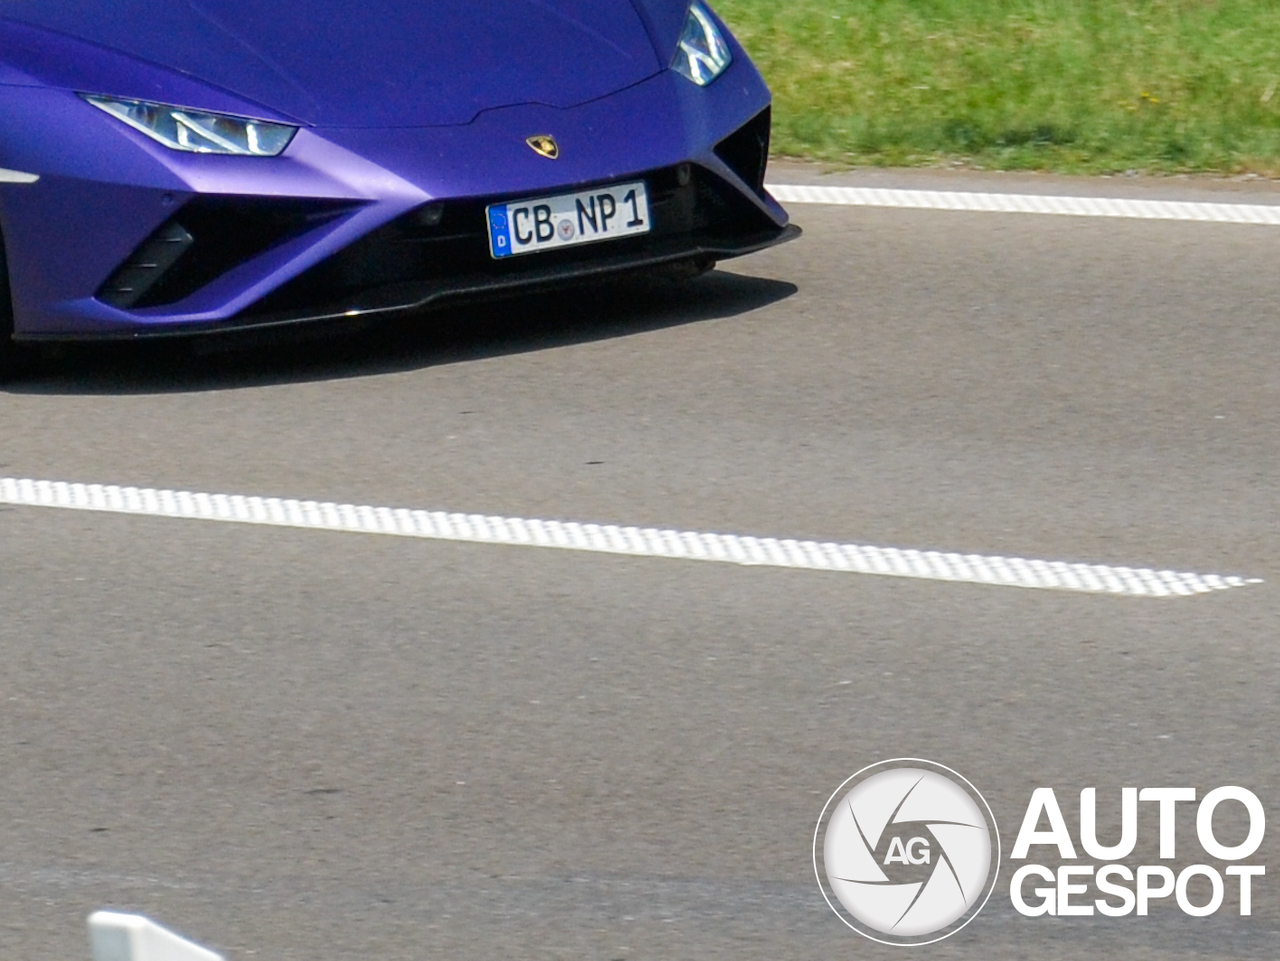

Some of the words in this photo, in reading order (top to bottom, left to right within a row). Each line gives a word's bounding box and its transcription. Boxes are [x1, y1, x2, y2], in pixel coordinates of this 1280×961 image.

[512, 204, 555, 245] CB
[574, 193, 617, 235] NP
[623, 189, 644, 228] 1
[497, 235, 507, 248] D
